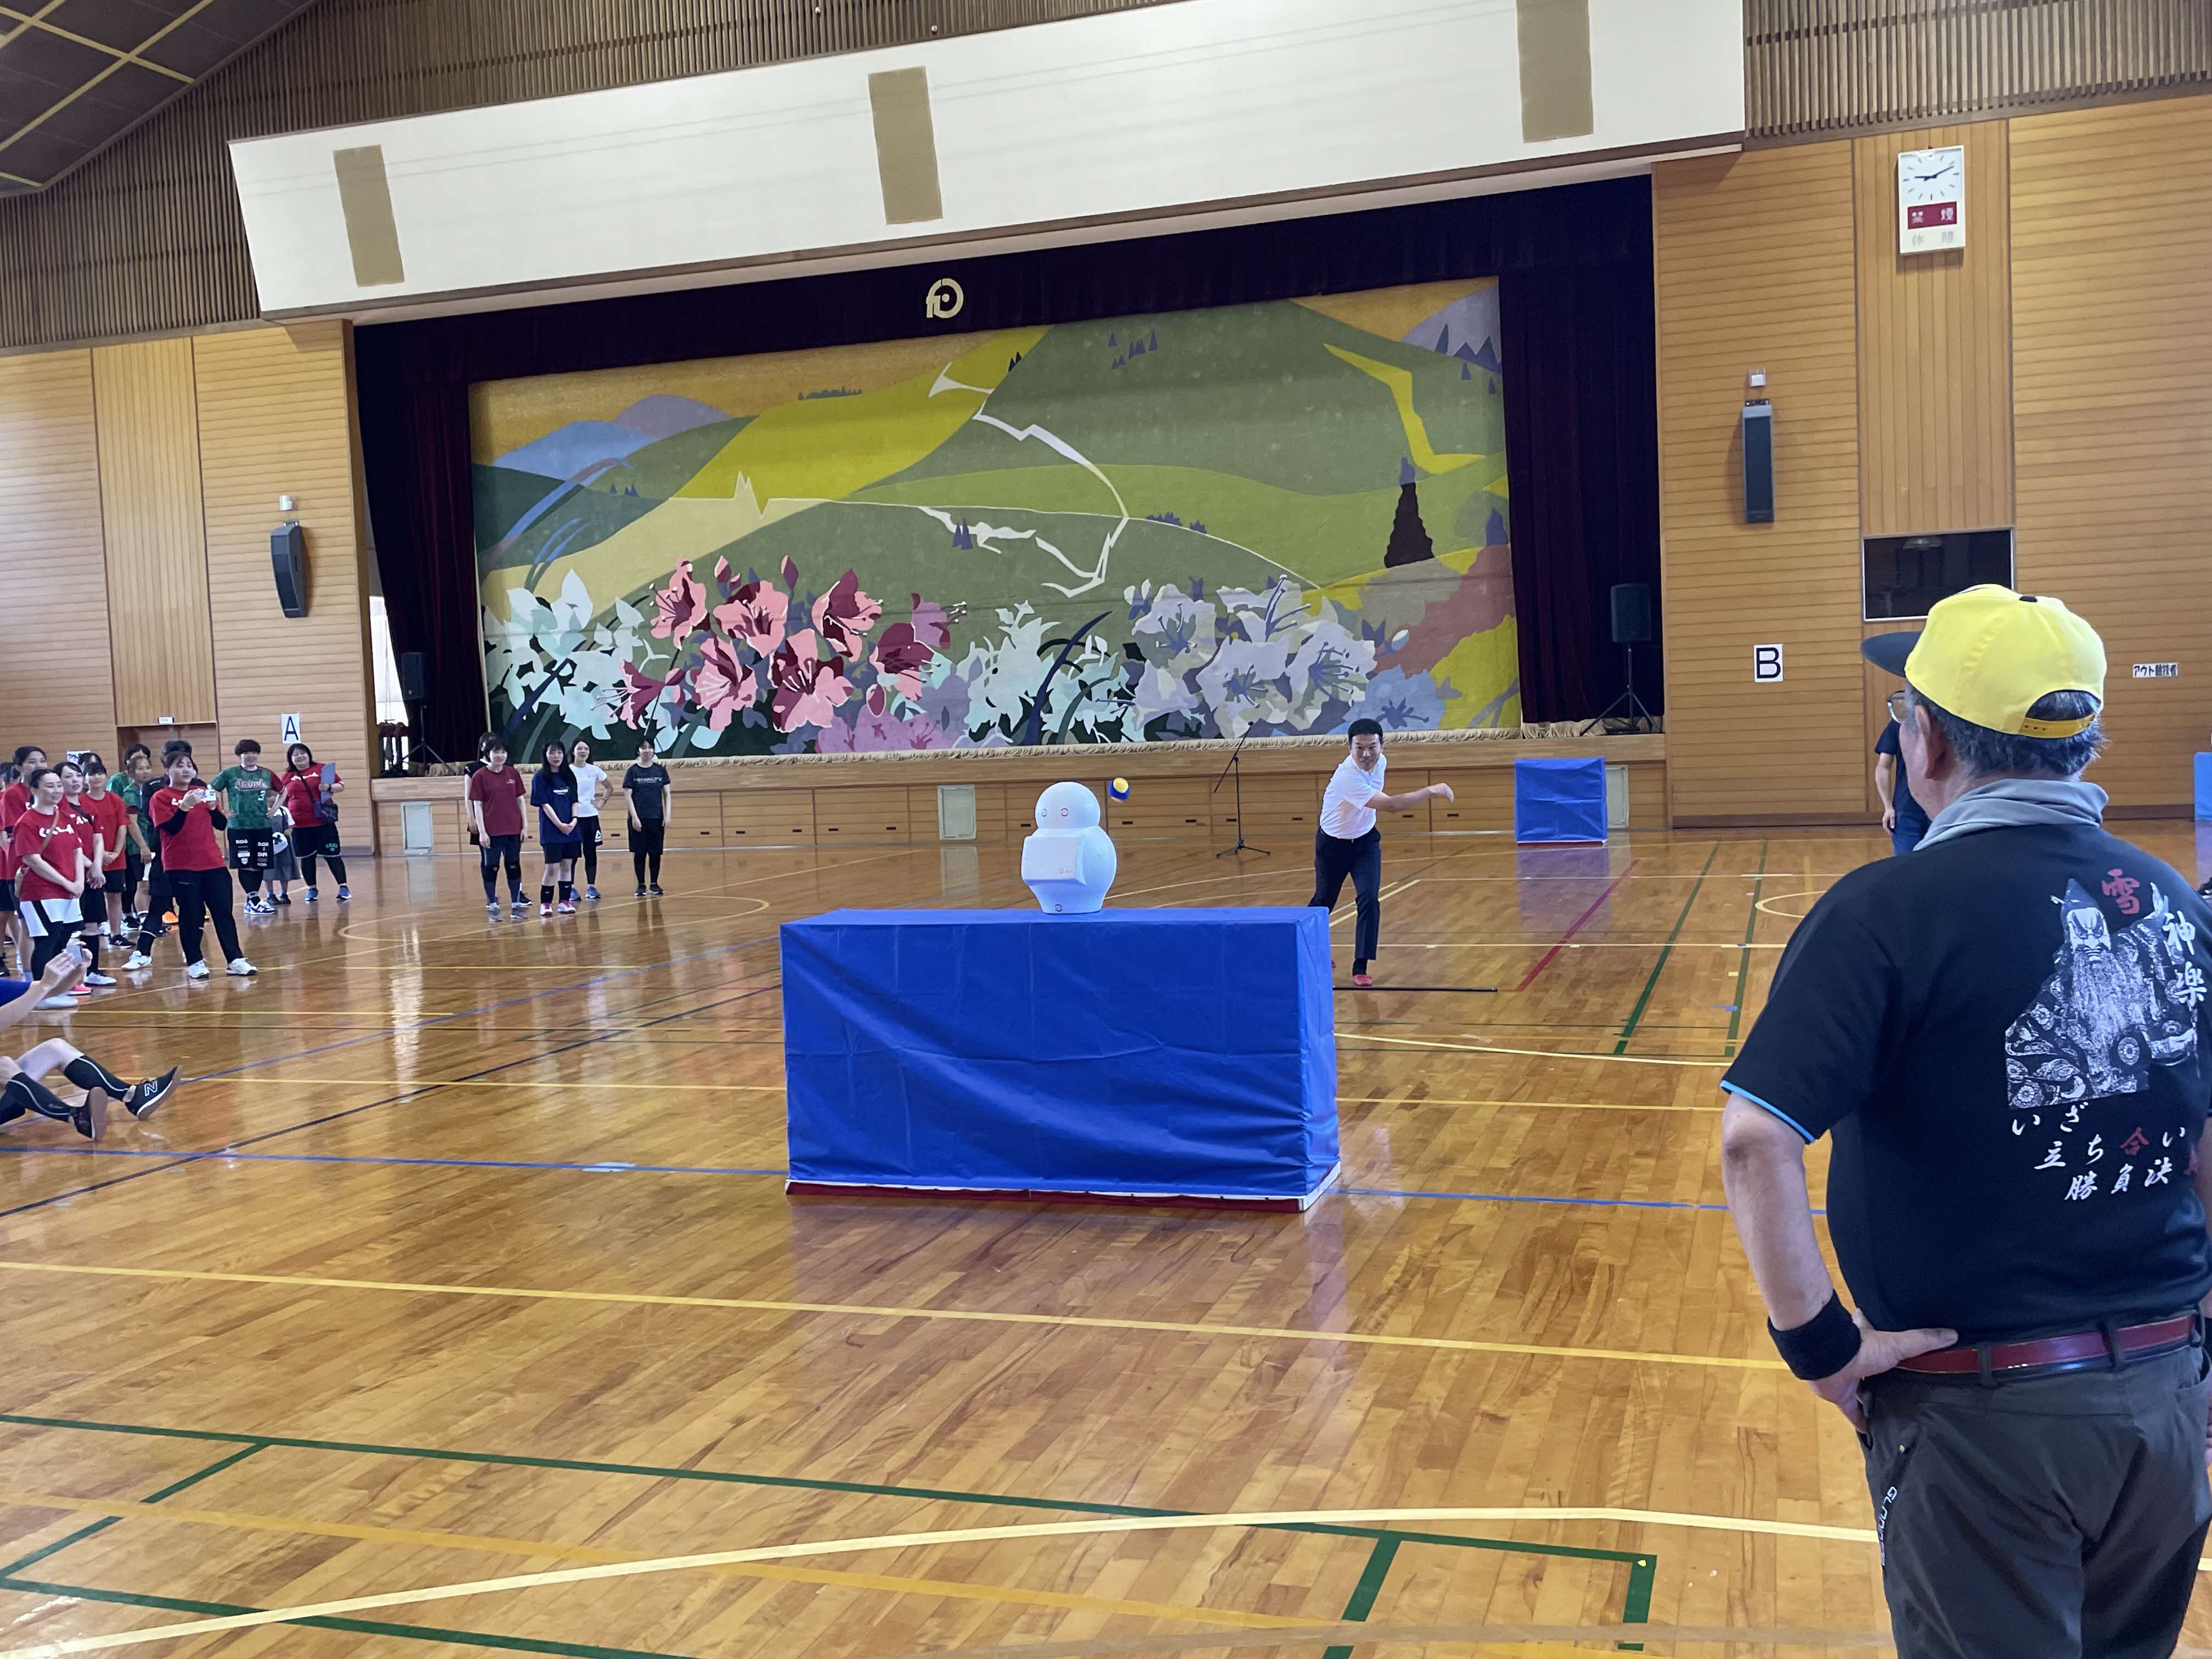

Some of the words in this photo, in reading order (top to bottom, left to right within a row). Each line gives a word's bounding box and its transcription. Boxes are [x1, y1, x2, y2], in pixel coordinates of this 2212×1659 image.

[1911, 207, 1953, 224] 禁煙
[1756, 647, 1781, 678] B
[284, 716, 298, 741] A
[258, 790, 266, 800] 3
[144, 1080, 157, 1097] N
[2012, 1102, 2089, 1136] いざ
[2034, 1127, 2186, 1170] 立ち合い
